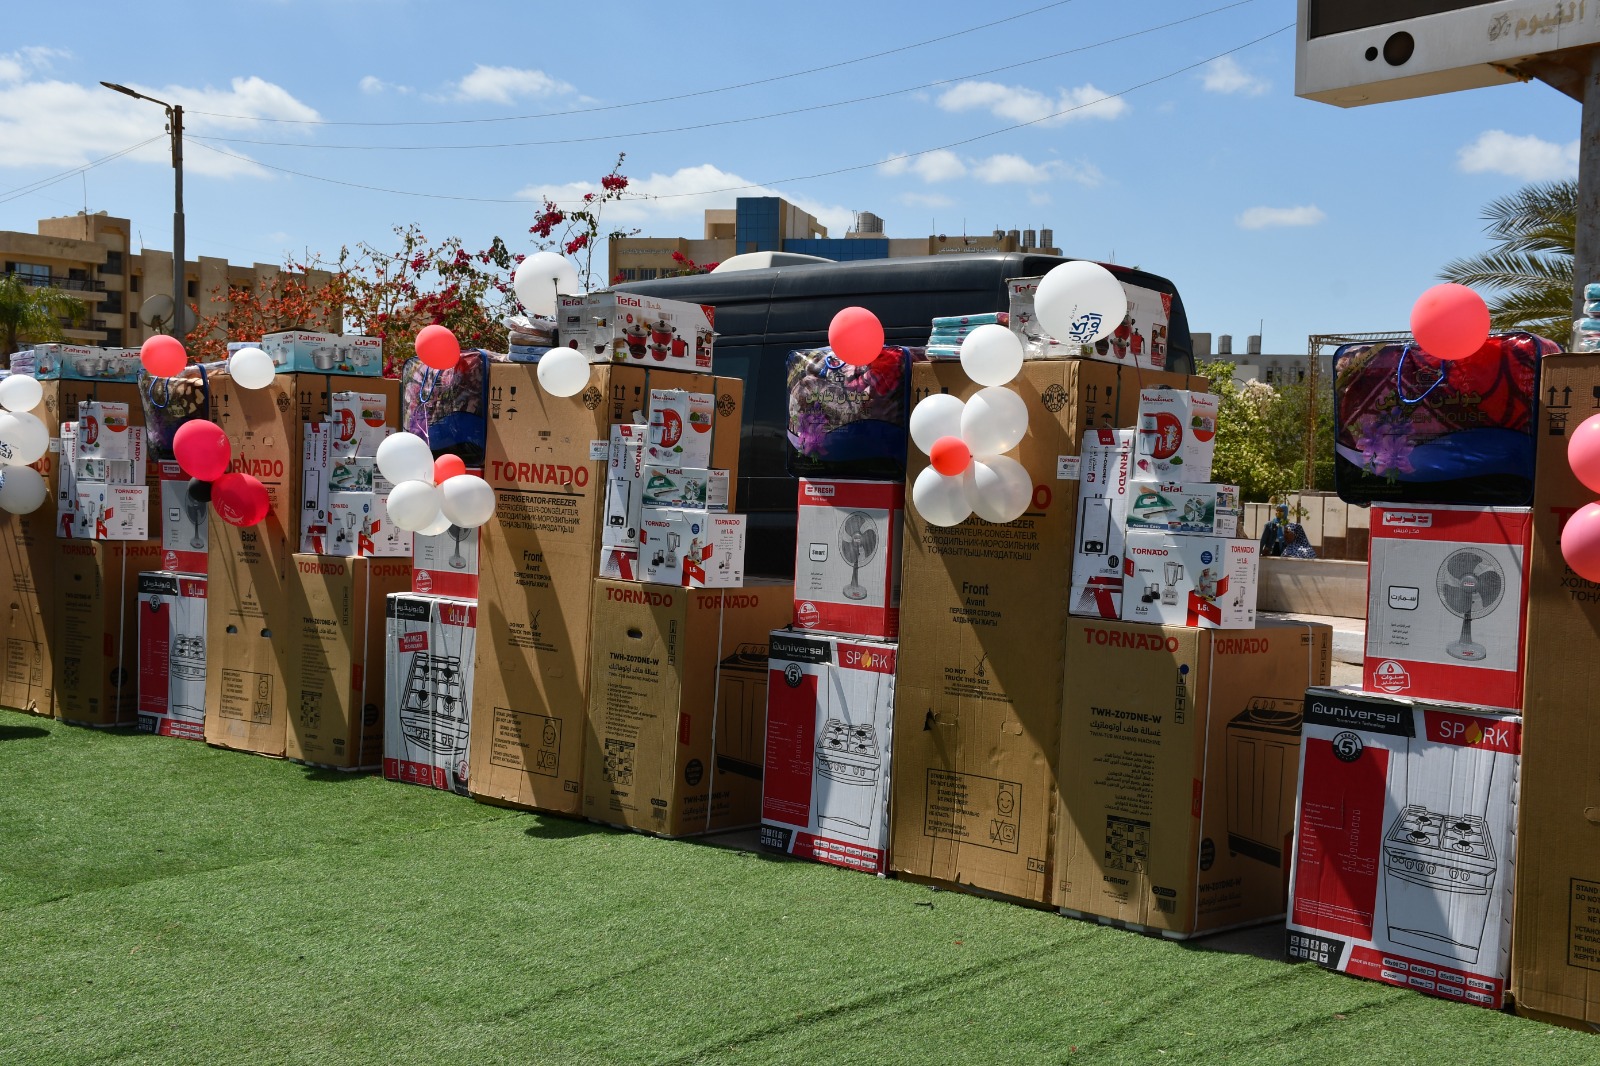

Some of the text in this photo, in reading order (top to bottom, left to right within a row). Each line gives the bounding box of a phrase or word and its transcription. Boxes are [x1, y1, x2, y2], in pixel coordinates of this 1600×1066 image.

[562, 298, 583, 306] Tefal
[616, 296, 642, 308] Tefal
[298, 334, 326, 342] Zahran
[64, 347, 91, 355] Zahran
[1142, 393, 1174, 402] Moulinex
[1437, 411, 1488, 423] HOUSE
[225, 459, 284, 477] ORNADO
[492, 460, 589, 488] TORNADO
[814, 486, 834, 494] FRESH
[1159, 484, 1183, 493] Tefal
[499, 493, 577, 507] REFRIGERATOR-FREEZER
[645, 520, 670, 528] TORNADO
[1385, 513, 1417, 523] فريش
[241, 531, 257, 541] Back
[922, 535, 1040, 551] ХОЛОДИЛЬНИК-МОРОЗИЛЬНИК
[62, 544, 97, 557] TORNADO
[1131, 547, 1169, 557] TORNADO
[1231, 545, 1255, 554] TORNADO
[523, 550, 543, 562] Front
[298, 561, 345, 576] TORNADO
[364, 564, 412, 577] TORNA
[526, 563, 540, 572] Avant
[962, 581, 989, 596] Front
[605, 587, 673, 608] TORNADO
[696, 594, 759, 610] TORNADO
[965, 596, 986, 607] Avant
[1390, 593, 1417, 602] سمارت
[1083, 627, 1179, 653] TORNADO
[1209, 637, 1269, 655] TORNADO
[779, 643, 824, 656] universal
[609, 652, 660, 666] TWH-Z07DNE-W
[788, 671, 798, 681] 5
[945, 674, 963, 683] TRUCK
[964, 676, 976, 684] THIS
[1090, 707, 1162, 724] TWH-Z07DNE-W
[1323, 706, 1401, 724] universal
[1089, 721, 1161, 737] غسالة هاف أوتوماتيك
[1089, 731, 1161, 746] TWIN-TUB WASHING MACHINE
[1341, 741, 1353, 756] 5
[1575, 884, 1598, 894] STAND
[1575, 893, 1586, 901] DO
[1587, 915, 1597, 923] NE
